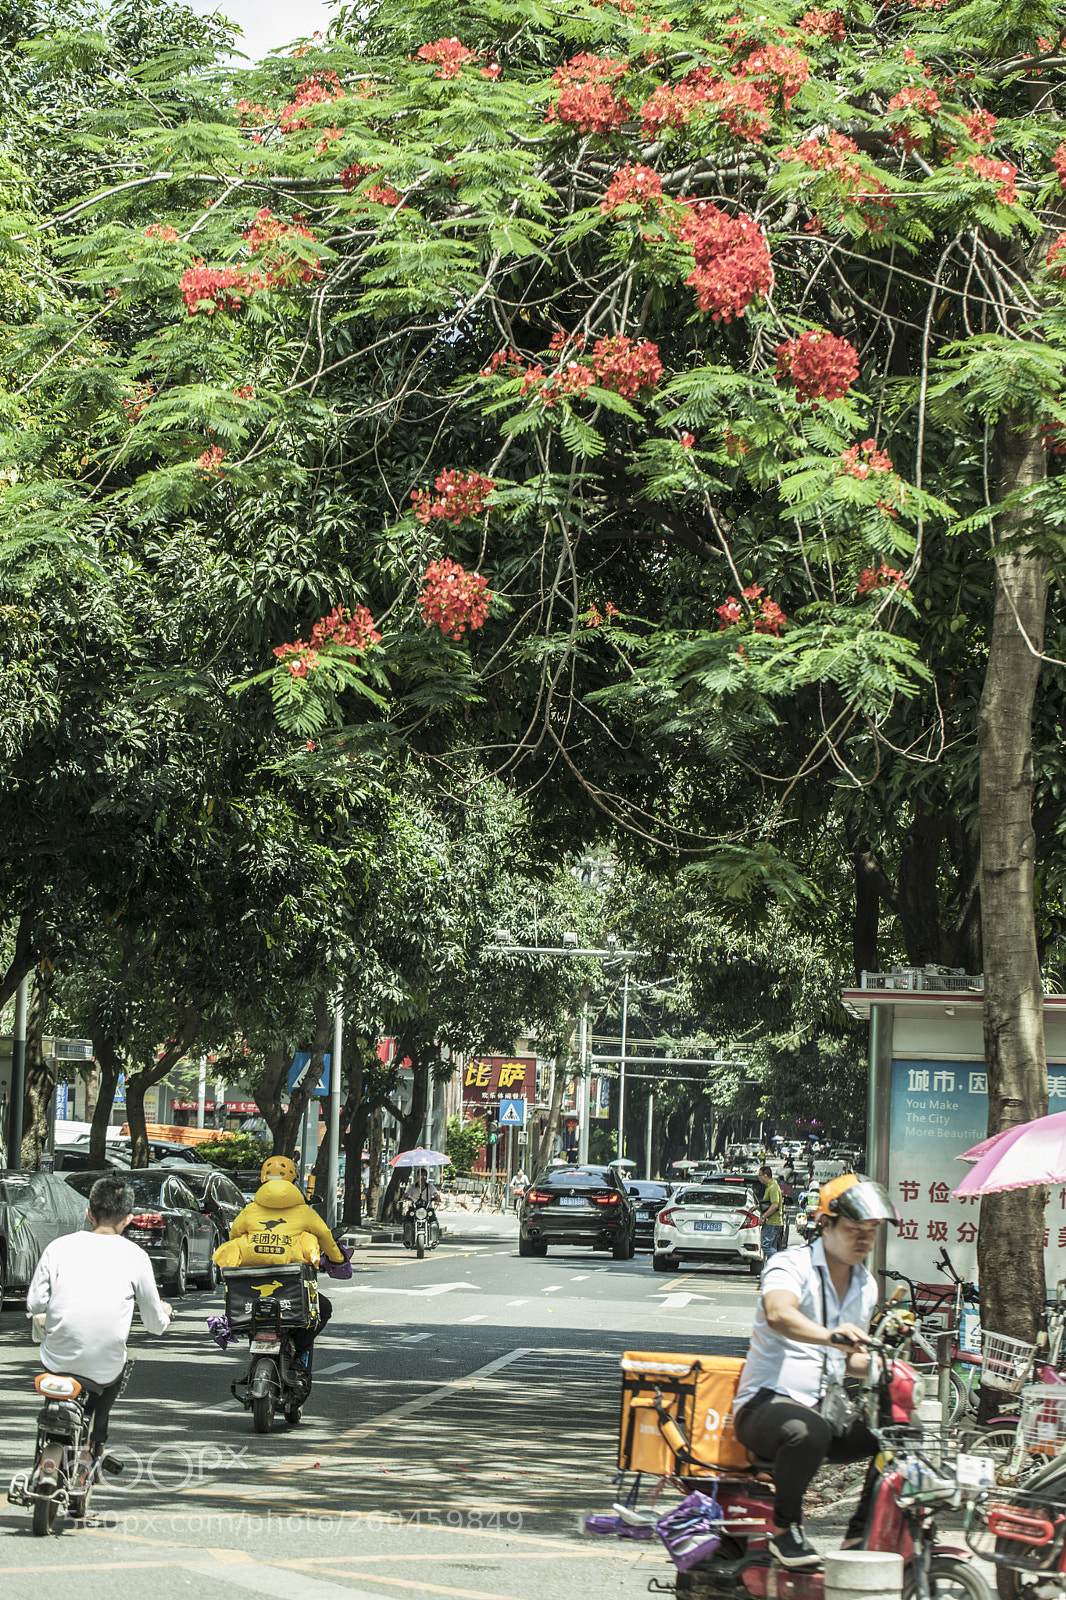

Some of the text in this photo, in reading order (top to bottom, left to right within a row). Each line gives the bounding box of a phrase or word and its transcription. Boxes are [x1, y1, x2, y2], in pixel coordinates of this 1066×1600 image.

[465, 1062, 527, 1088] 比萨
[906, 1099, 959, 1110] You Make
[906, 1113, 950, 1126] The City
[905, 1127, 987, 1139] More Beautiful
[897, 1218, 979, 1243] 垃圾分
[250, 1233, 292, 1247] 美团外卖
